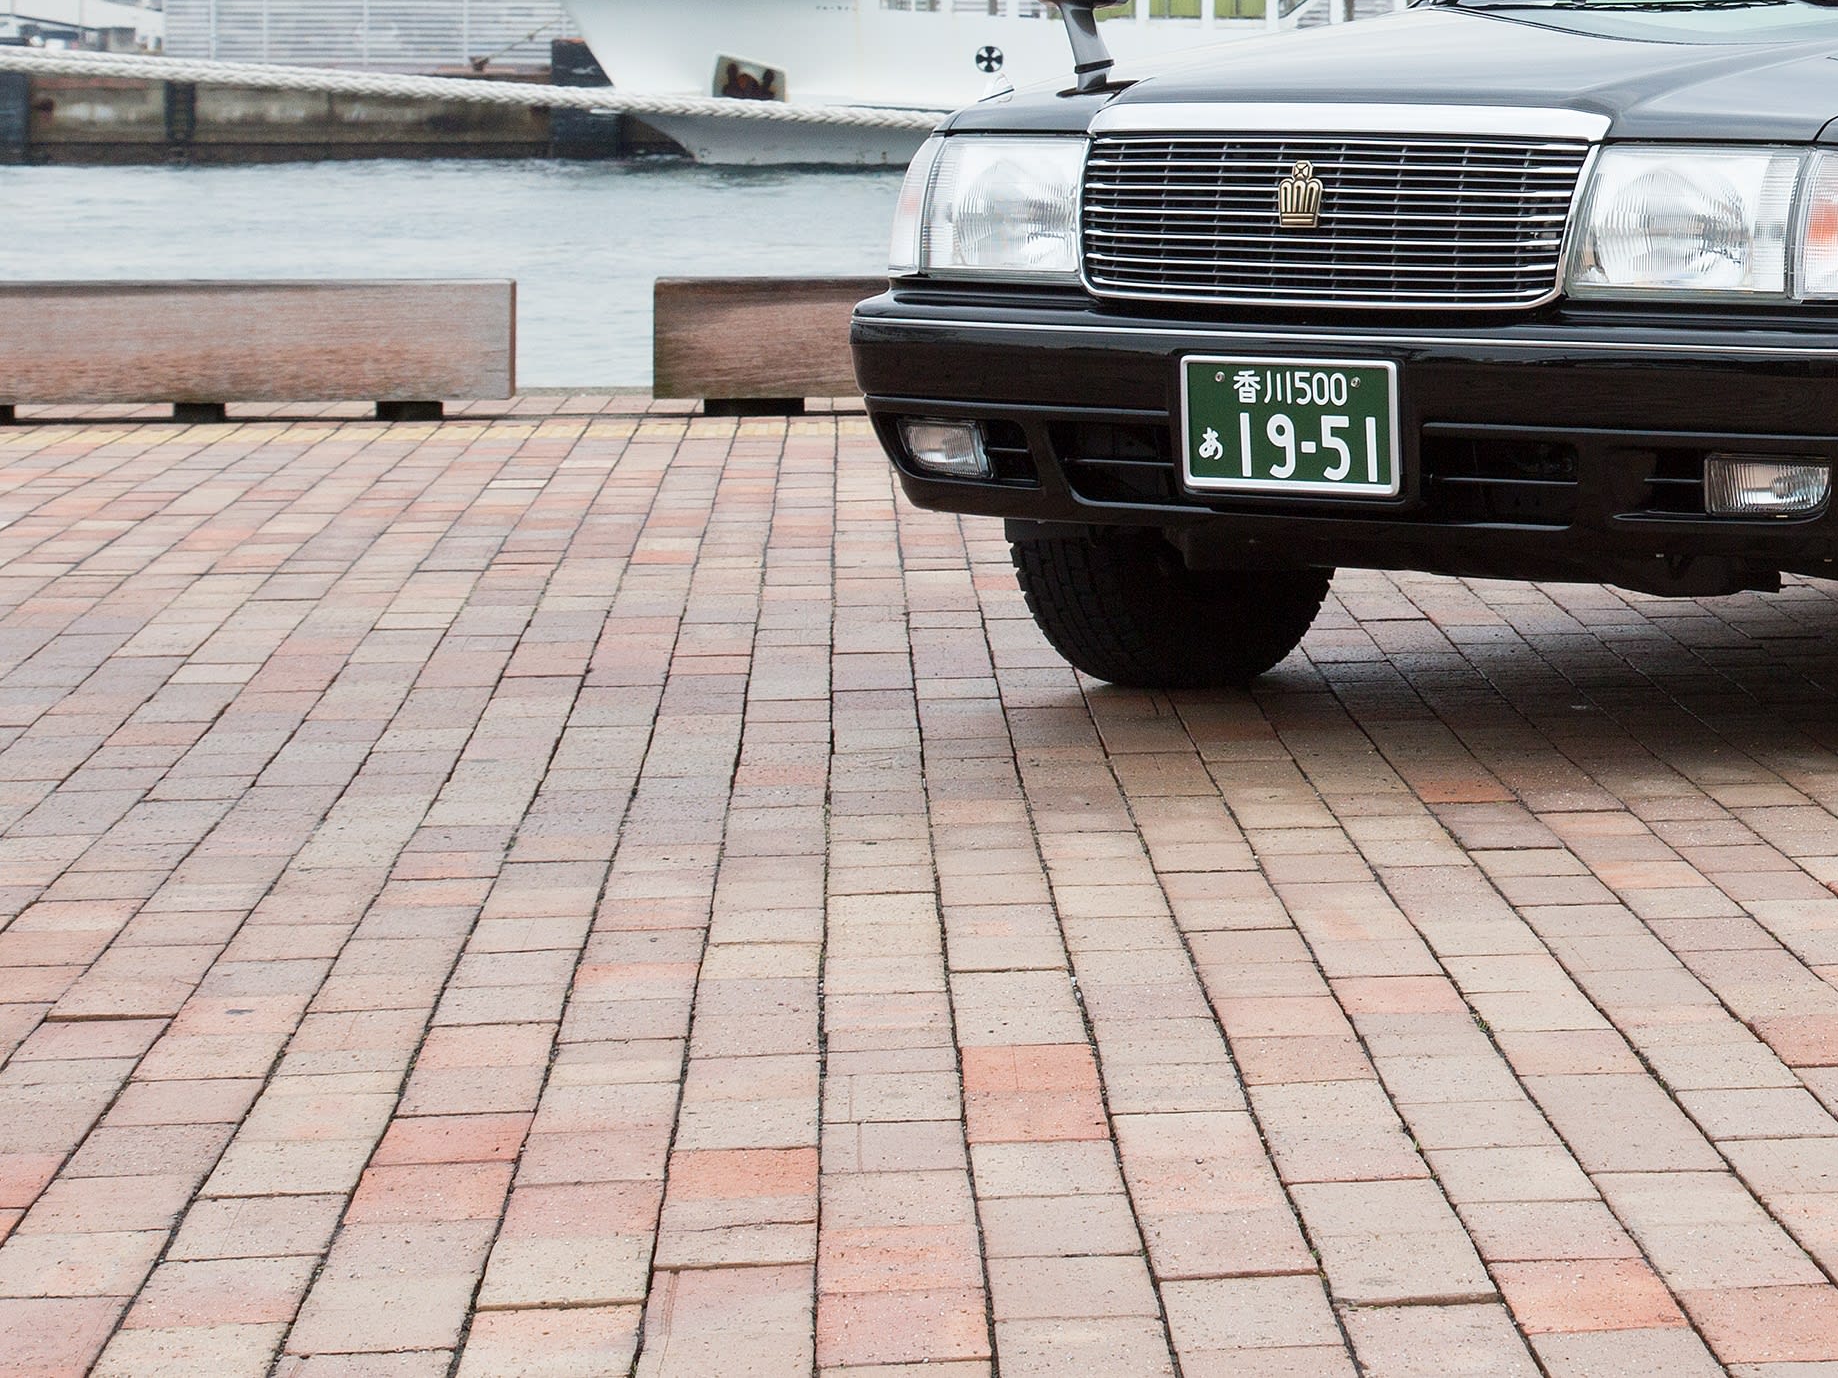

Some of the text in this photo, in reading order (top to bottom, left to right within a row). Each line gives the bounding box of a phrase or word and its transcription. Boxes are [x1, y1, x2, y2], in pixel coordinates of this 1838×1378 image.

[1232, 370, 1348, 406] 香川500
[1198, 427, 1224, 460] あ
[1239, 411, 1379, 483] 19-51
